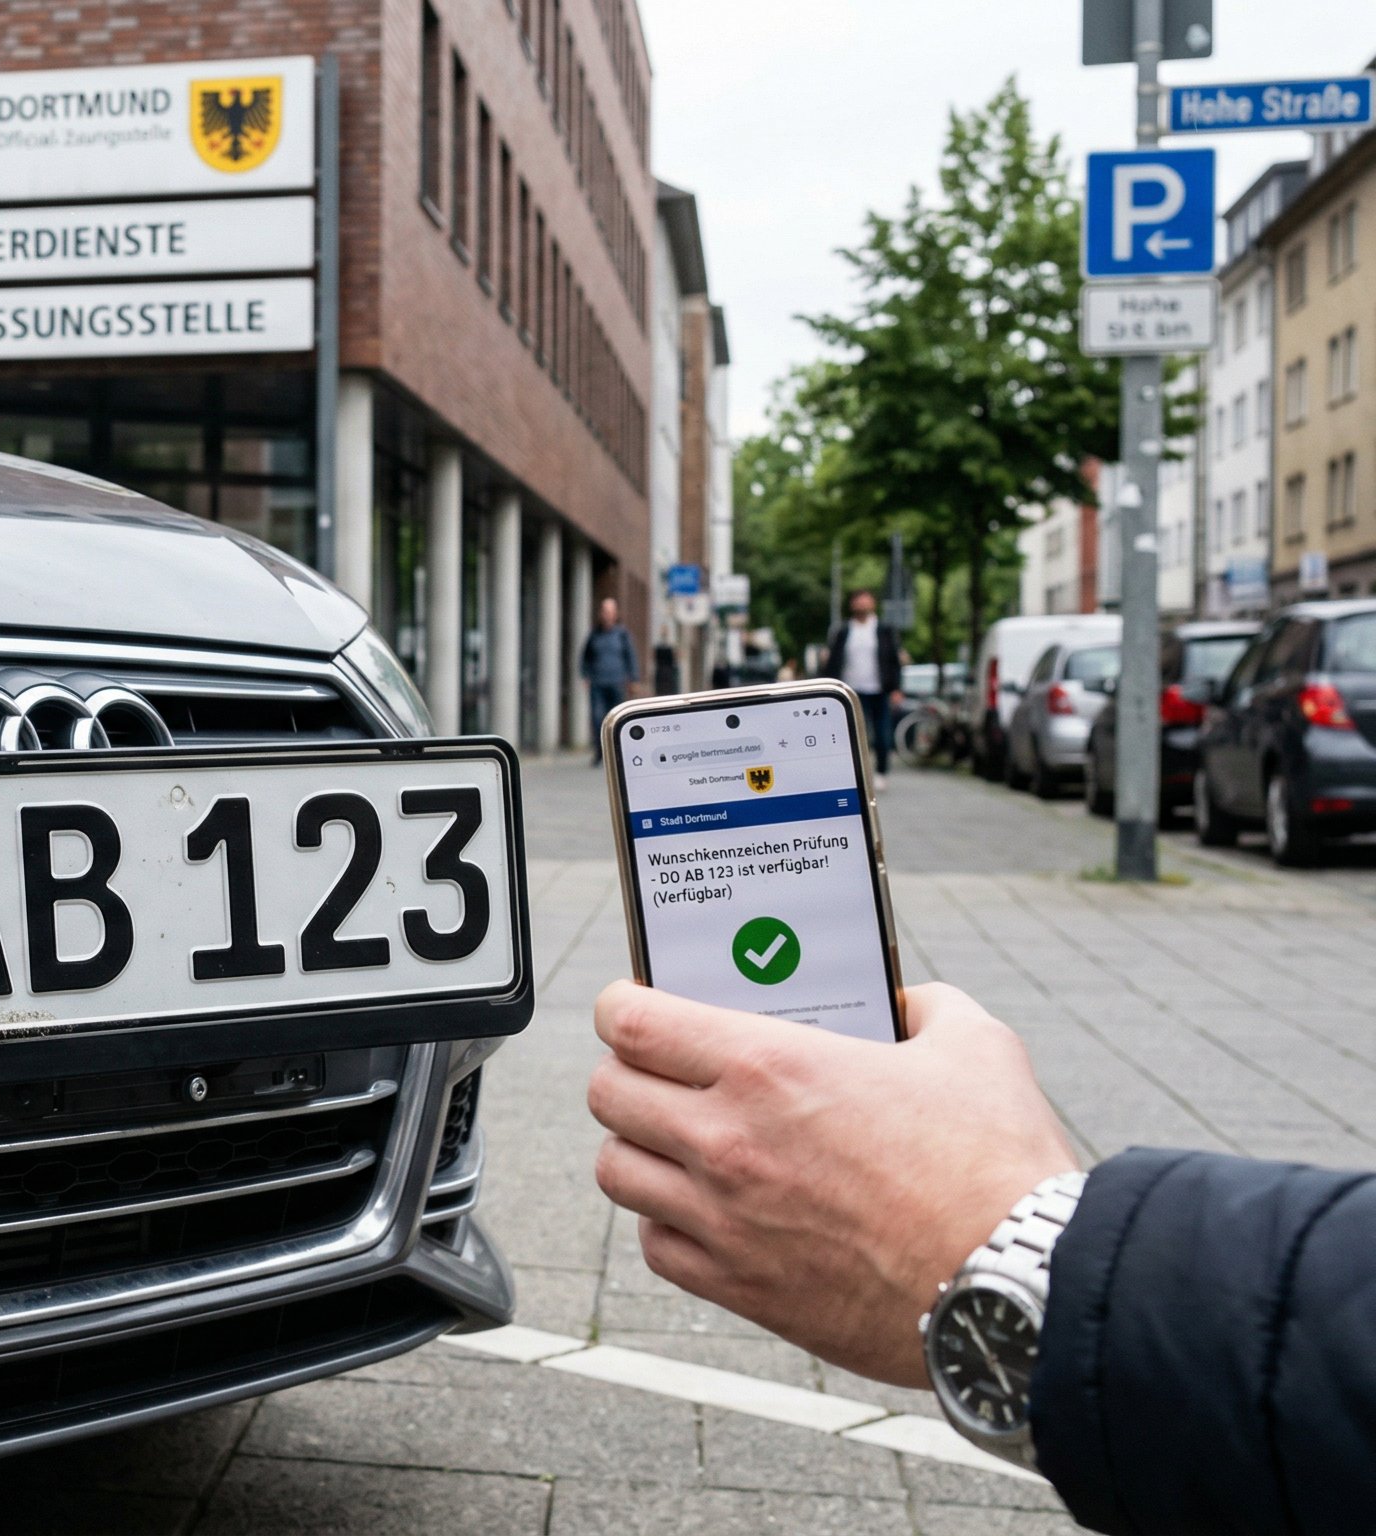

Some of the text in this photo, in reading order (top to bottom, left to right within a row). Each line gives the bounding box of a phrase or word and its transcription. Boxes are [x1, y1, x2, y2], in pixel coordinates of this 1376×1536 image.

[1181, 83, 1360, 126] Hohe Straße
[1112, 163, 1186, 262] P
[648, 835, 850, 867] Wunschkennzeichen Prüfung
[183, 786, 491, 983] 123
[660, 870, 681, 885] DO
[684, 868, 705, 883] AB
[708, 865, 734, 880] 123
[738, 862, 755, 876] ist
[758, 855, 830, 874] verfügbar!
[653, 884, 733, 909] (Verfügbar)
